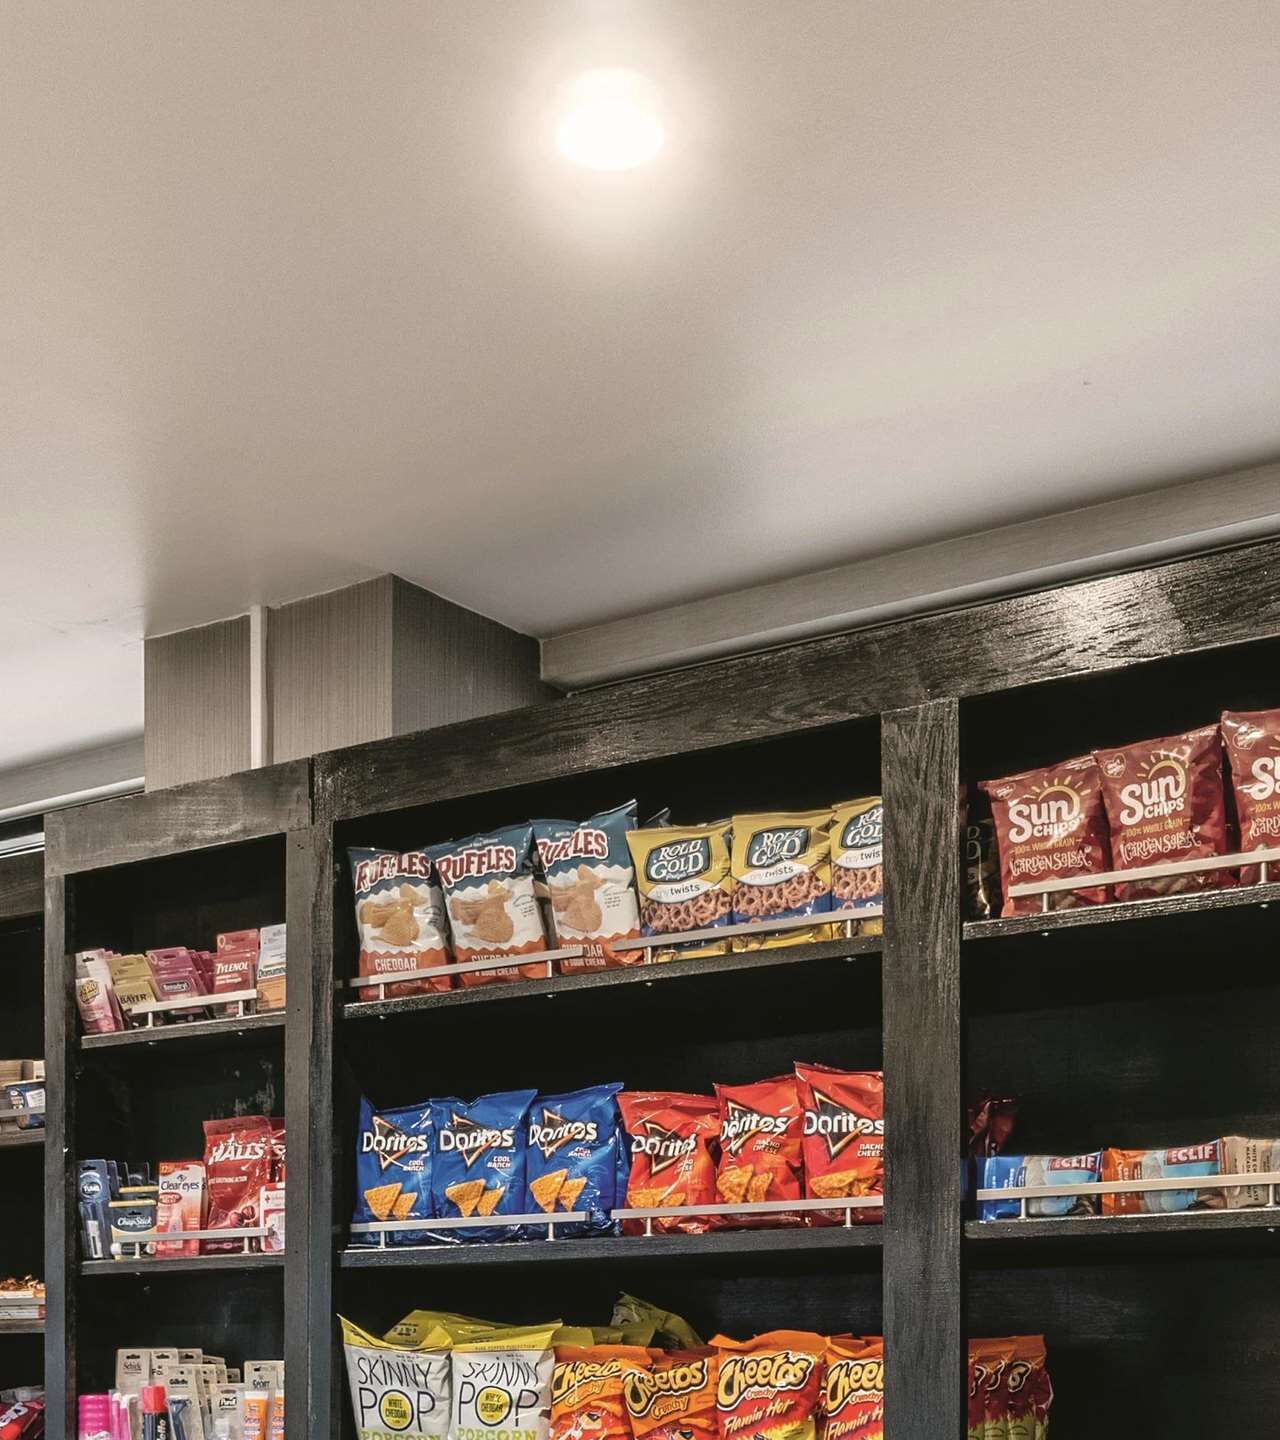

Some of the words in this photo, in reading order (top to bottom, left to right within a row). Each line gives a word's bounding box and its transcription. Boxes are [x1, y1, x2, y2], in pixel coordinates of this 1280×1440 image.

[1120, 775, 1183, 825] Sun
[1144, 797, 1184, 818] CHIPS
[1008, 800, 1079, 843] Sun
[660, 841, 703, 856] ROLD
[752, 836, 800, 867] GOLD
[355, 852, 430, 892] RUFFLES
[436, 846, 516, 887] RUFFLES
[650, 852, 703, 879] GOLD
[216, 962, 249, 974] TYLENOL
[375, 957, 417, 971] CHEDDAR
[120, 993, 147, 1003] BAYER
[363, 1132, 428, 1152] Doritos
[440, 1129, 516, 1151] Doritos
[529, 1122, 598, 1145] Doritos
[209, 1139, 265, 1165] HALLS
[1062, 1156, 1096, 1170] CLIF
[1178, 1146, 1214, 1162] CLIF
[161, 1181, 182, 1190] Clear
[182, 1181, 199, 1191] eyes
[357, 1356, 432, 1389] SKINNY
[463, 1357, 540, 1387] SKINNY
[718, 1353, 810, 1408] Cheetos
[624, 1360, 706, 1415] Cheetos
[359, 1387, 435, 1432] POP
[458, 1381, 539, 1427] POP
[652, 1396, 689, 1419] Crunchy
[766, 1399, 793, 1420] Hot
